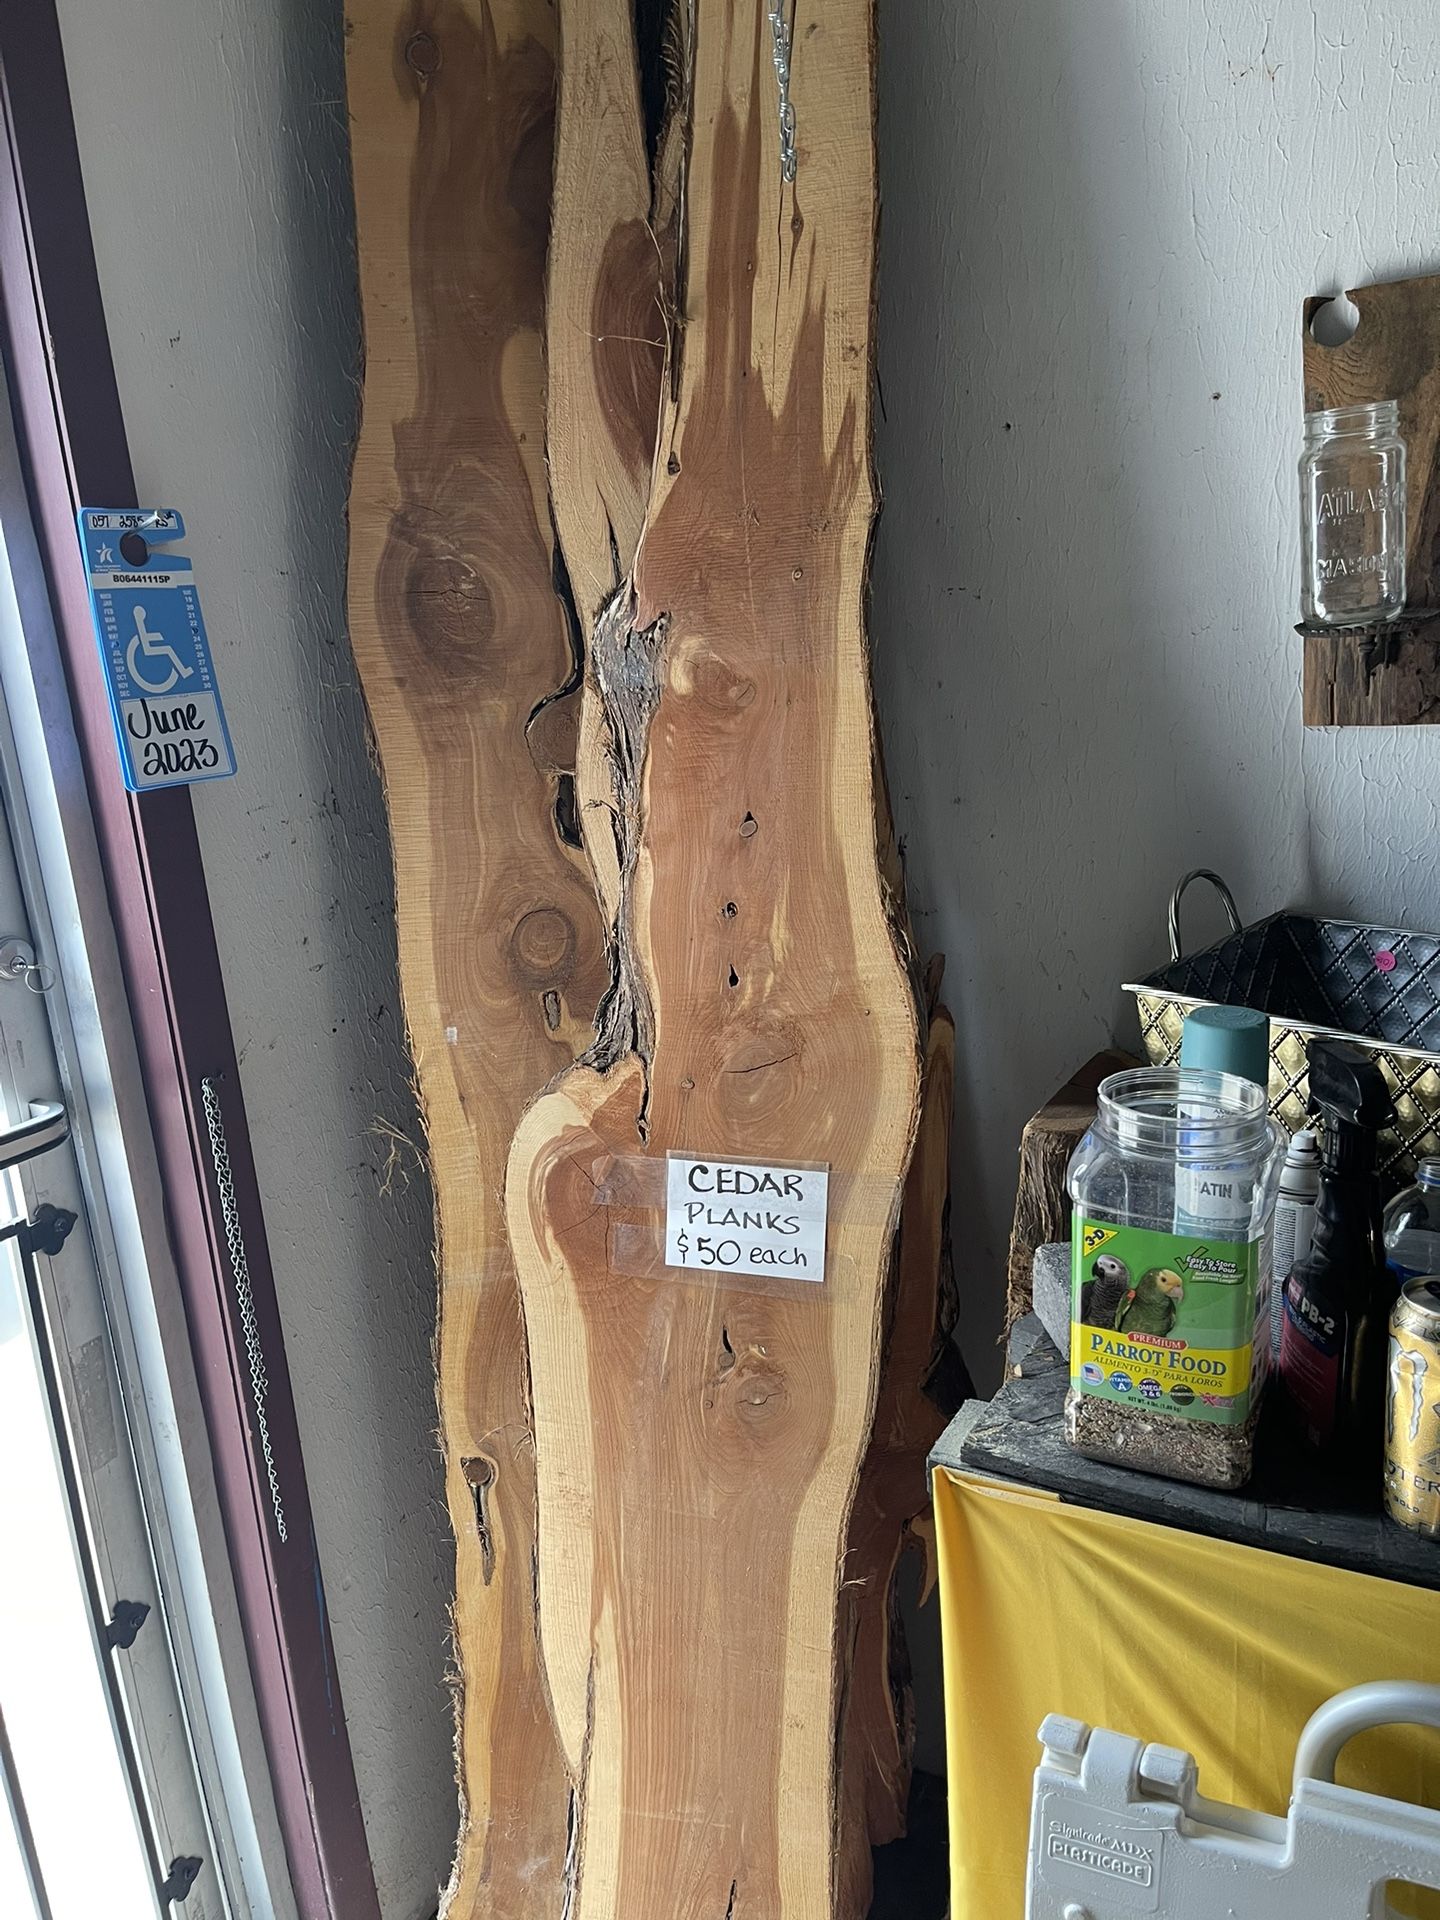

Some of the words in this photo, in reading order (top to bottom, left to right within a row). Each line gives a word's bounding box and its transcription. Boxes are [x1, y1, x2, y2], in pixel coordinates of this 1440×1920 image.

[113, 575, 170, 583] B06441115P
[128, 698, 205, 739] June
[143, 738, 219, 776] 2023
[688, 1164, 804, 1201] CEDAR
[684, 1201, 801, 1235] PLANKS
[1085, 1229, 1105, 1246] 3-D
[749, 1247, 808, 1267] each
[1186, 1255, 1204, 1265] Easy
[1215, 1260, 1236, 1269] Store
[1188, 1263, 1207, 1271] Easy
[1301, 1297, 1335, 1335] PB-2
[1133, 1333, 1181, 1349] PREMIUM
[1093, 1355, 1141, 1373] ALIMENTO
[1163, 1372, 1188, 1383] PARA
[1191, 1377, 1223, 1388] LOROS
[1118, 1382, 1127, 1392] A
[1053, 1840, 1145, 1878] PLASTICADE
[1111, 1839, 1153, 1860] MDX
